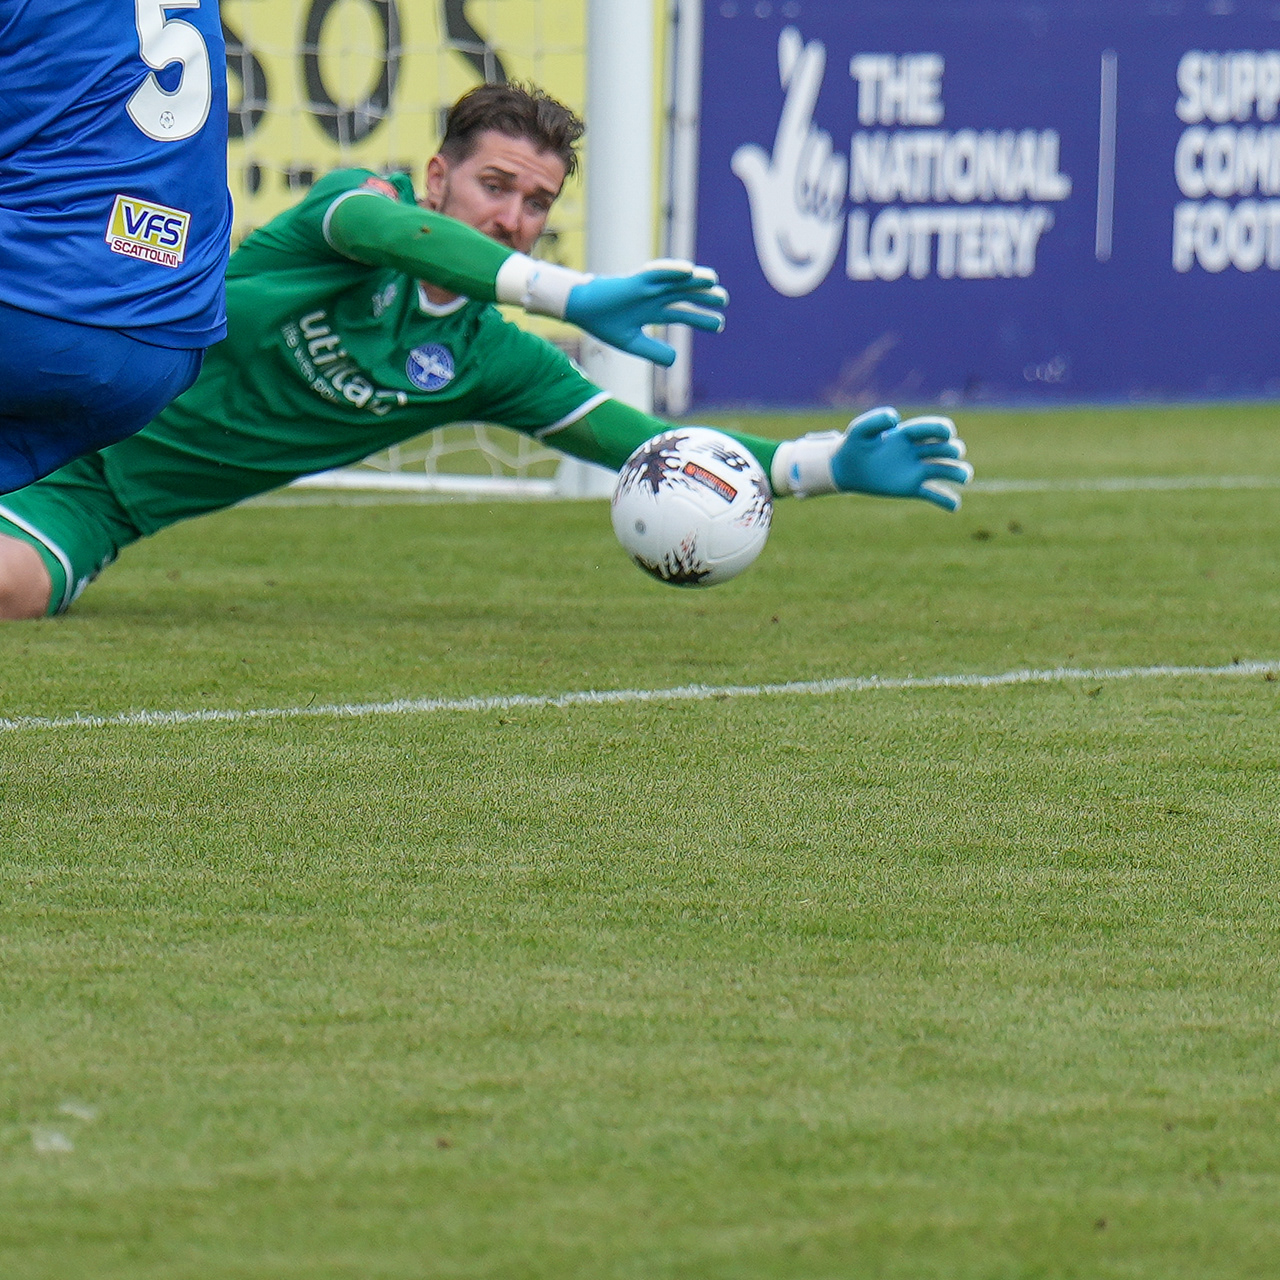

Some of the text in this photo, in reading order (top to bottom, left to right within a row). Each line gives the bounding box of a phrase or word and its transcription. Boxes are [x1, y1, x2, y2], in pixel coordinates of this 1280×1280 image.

[849, 52, 945, 125] THE
[849, 128, 1072, 202] NATIONAL
[113, 239, 177, 266] SCATTOLINI
[124, 205, 182, 246] VFS
[845, 206, 1055, 281] LOTTERY
